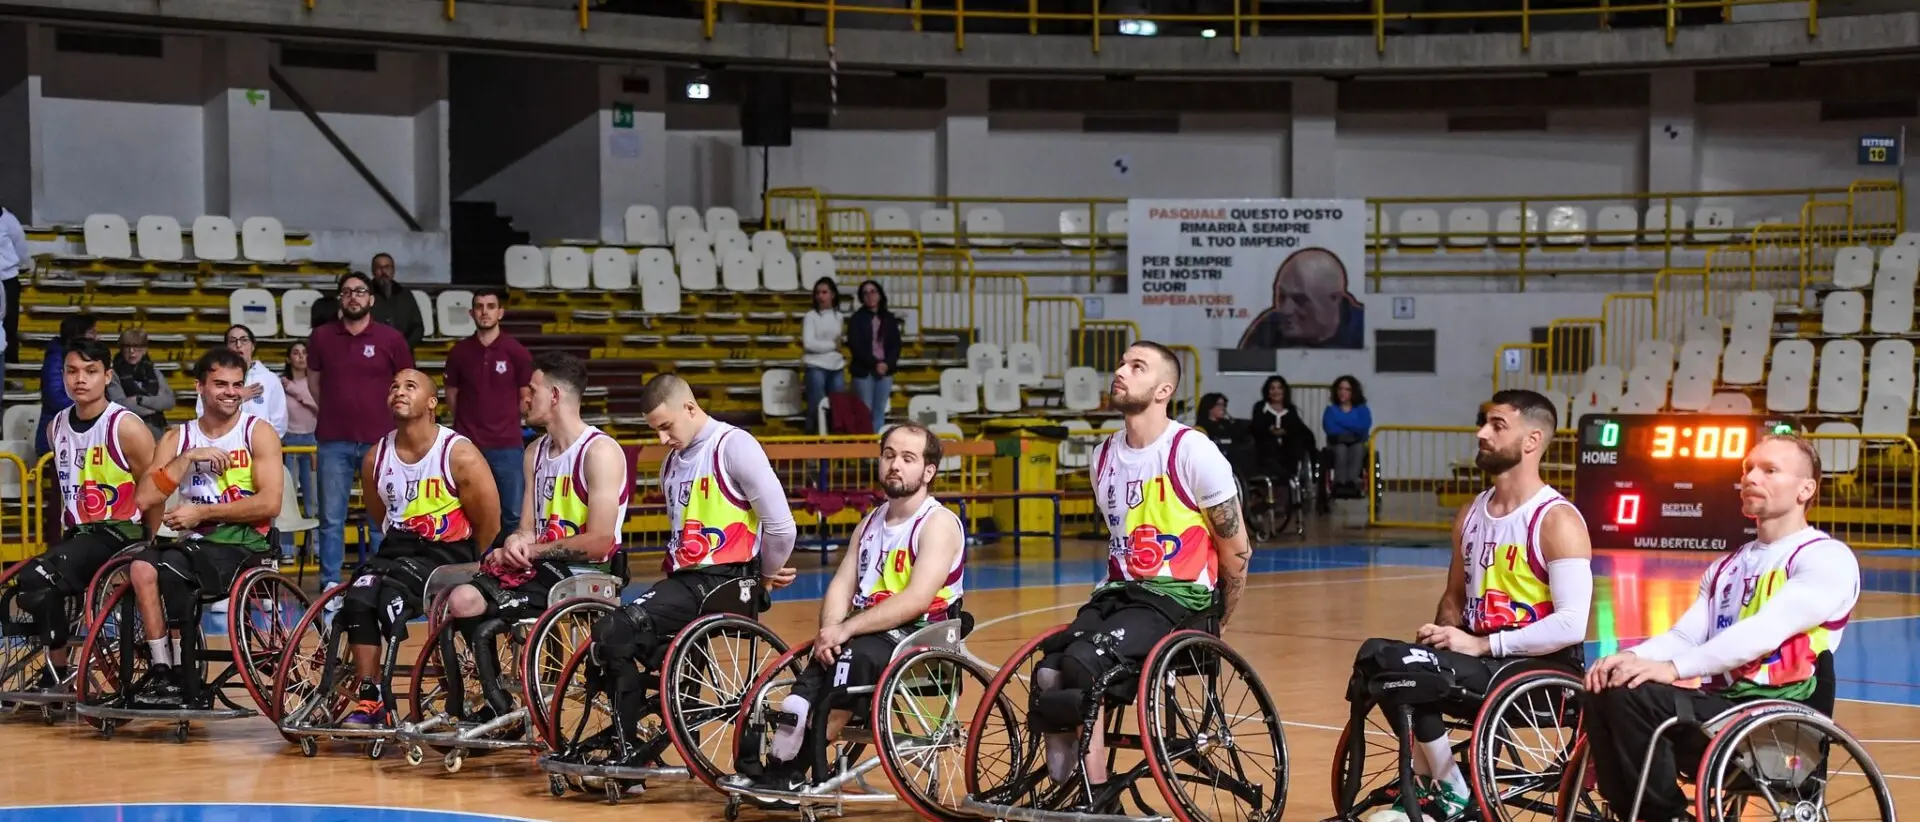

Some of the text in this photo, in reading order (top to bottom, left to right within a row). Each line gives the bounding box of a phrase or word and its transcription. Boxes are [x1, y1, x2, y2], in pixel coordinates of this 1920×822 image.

[1870, 149, 1885, 160] 10
[1149, 208, 1343, 220] PASQUALE QUESTO POSTO
[1180, 221, 1311, 234] RIMARRÀ SEMPRE
[1191, 236, 1300, 247] IL TUO IMPERO!
[1142, 255, 1233, 267] PER SEMPRE
[1142, 268, 1222, 280] NEI NOSTRI
[1142, 281, 1187, 293] CUORI
[1142, 294, 1234, 305] IMPERATORE
[1601, 423, 1619, 446] 0
[1651, 425, 1748, 458] 3:00
[92, 446, 103, 465] 21
[229, 449, 249, 468] 20
[1581, 451, 1617, 464] HOME
[426, 478, 440, 498] 17
[1155, 477, 1165, 502] 7
[1616, 494, 1640, 524] 0
[1634, 537, 1727, 549] WWW.BERTELE.EU
[895, 549, 906, 573] 8
[1505, 544, 1518, 571] 4
